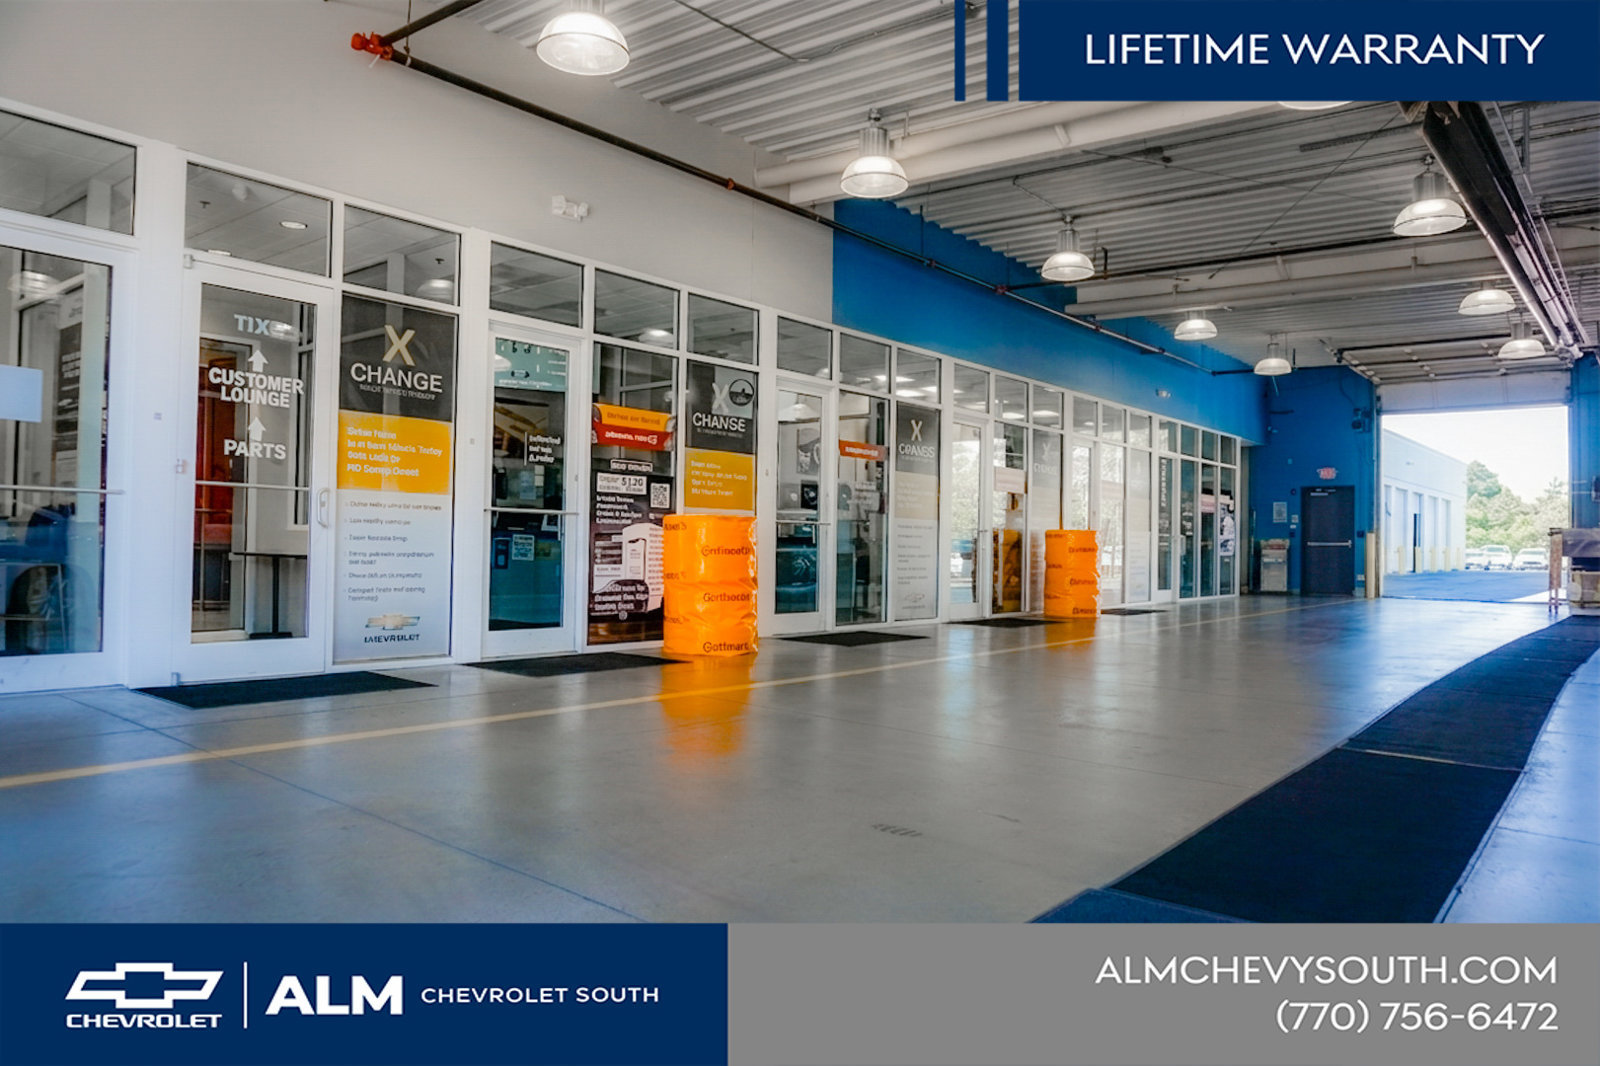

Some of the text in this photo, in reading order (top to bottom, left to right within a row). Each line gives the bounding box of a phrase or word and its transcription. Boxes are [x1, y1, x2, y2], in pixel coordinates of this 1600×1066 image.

[383, 324, 416, 367] X
[208, 366, 305, 396] CUSTOMER
[350, 362, 443, 393] CHANGE
[220, 384, 291, 409] LOUNGE
[223, 438, 287, 460] PARTS
